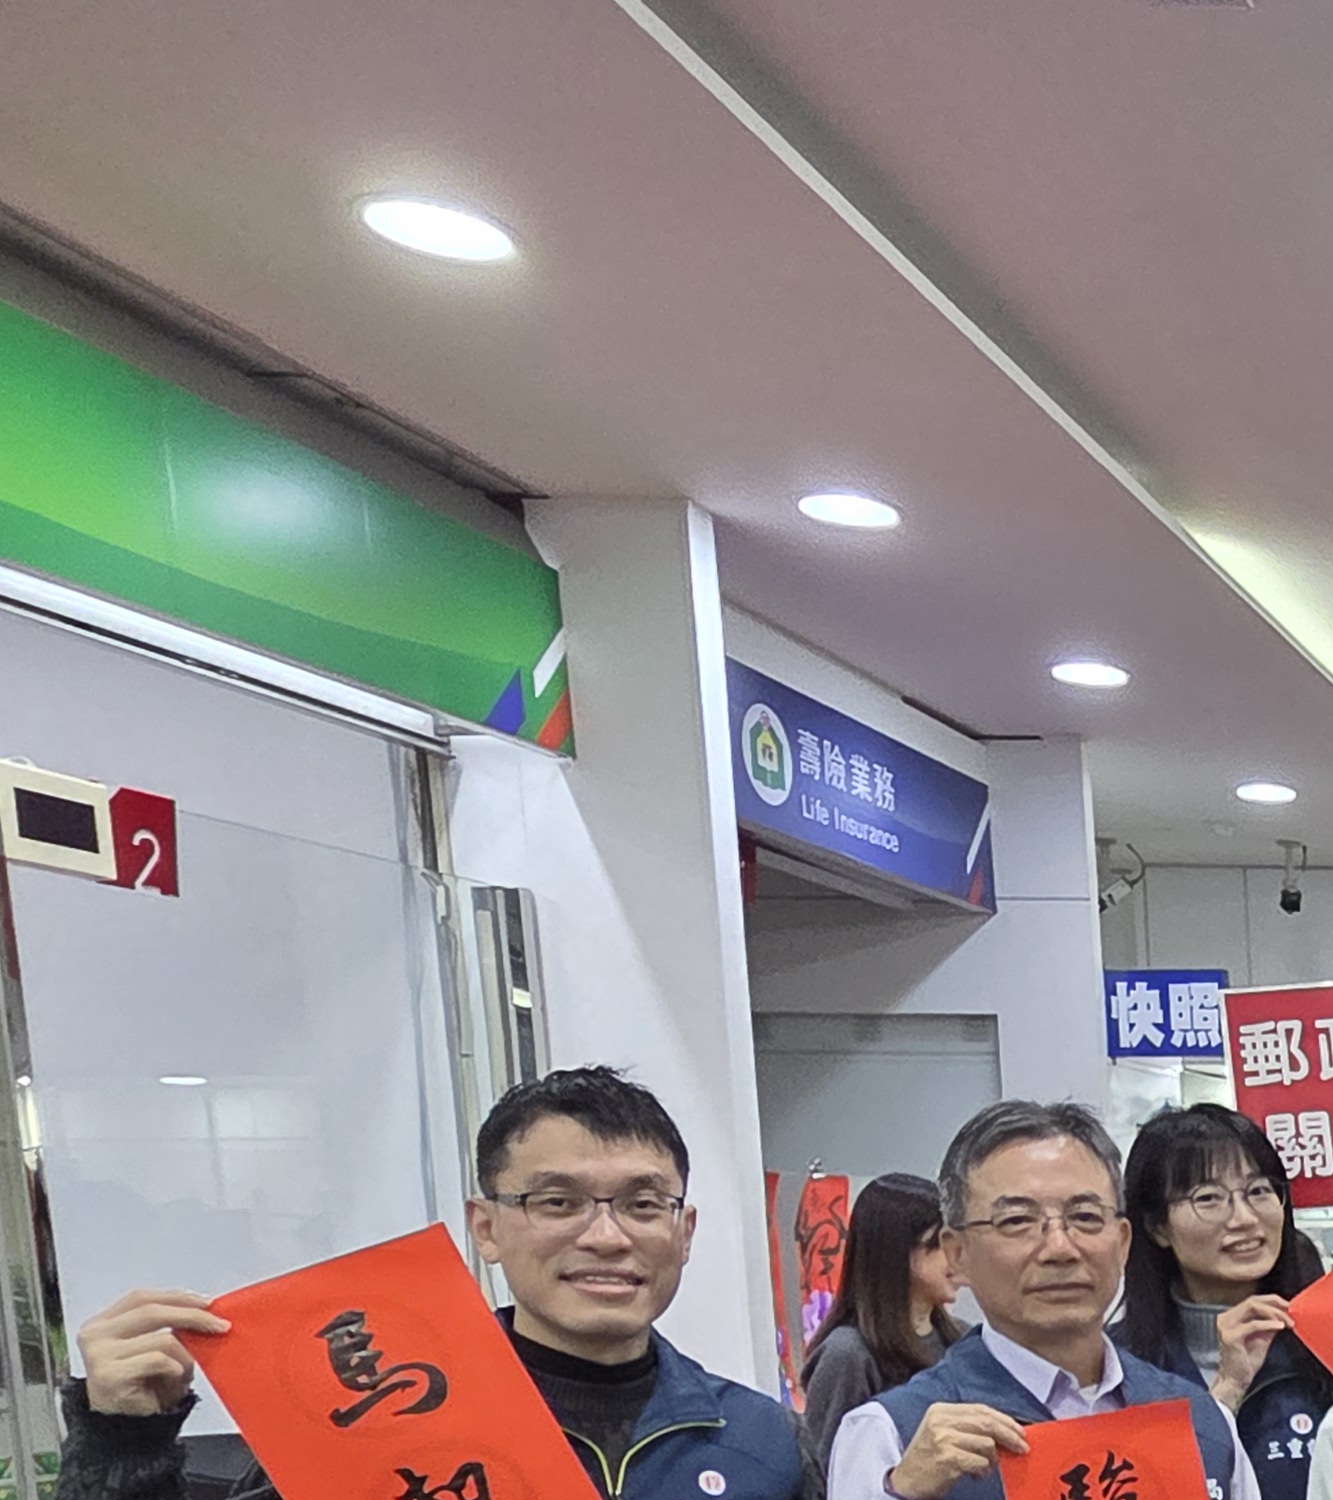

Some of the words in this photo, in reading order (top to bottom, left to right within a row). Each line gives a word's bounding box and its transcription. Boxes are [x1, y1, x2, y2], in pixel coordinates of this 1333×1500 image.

[797, 729, 896, 812] 壽險業務
[801, 794, 829, 825] Life
[834, 807, 900, 852] Insurance
[132, 829, 162, 892] 2
[1111, 981, 1221, 1048] 快照
